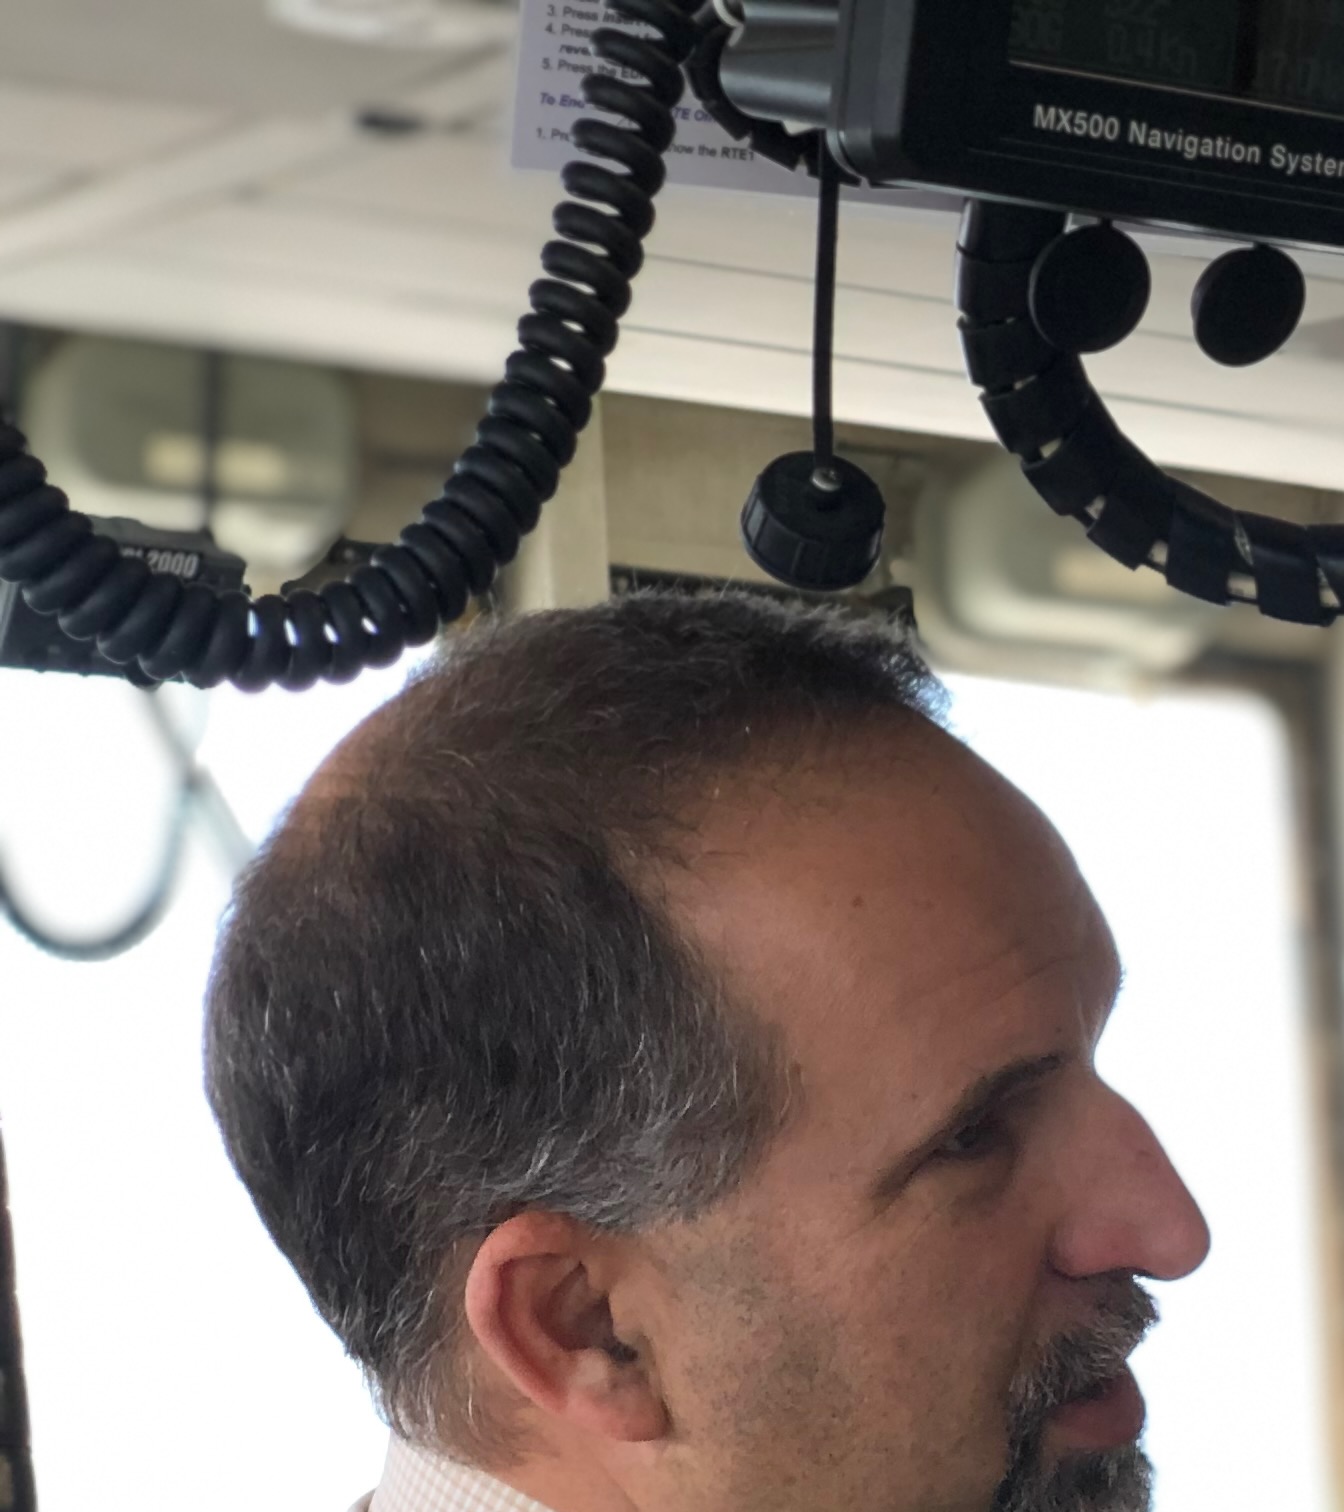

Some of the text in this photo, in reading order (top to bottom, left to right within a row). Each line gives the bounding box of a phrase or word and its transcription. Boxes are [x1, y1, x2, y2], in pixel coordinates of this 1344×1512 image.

[563, 6, 599, 22] Press
[540, 92, 556, 106] To
[1033, 103, 1121, 141] MX500
[1128, 120, 1262, 164] Navigation
